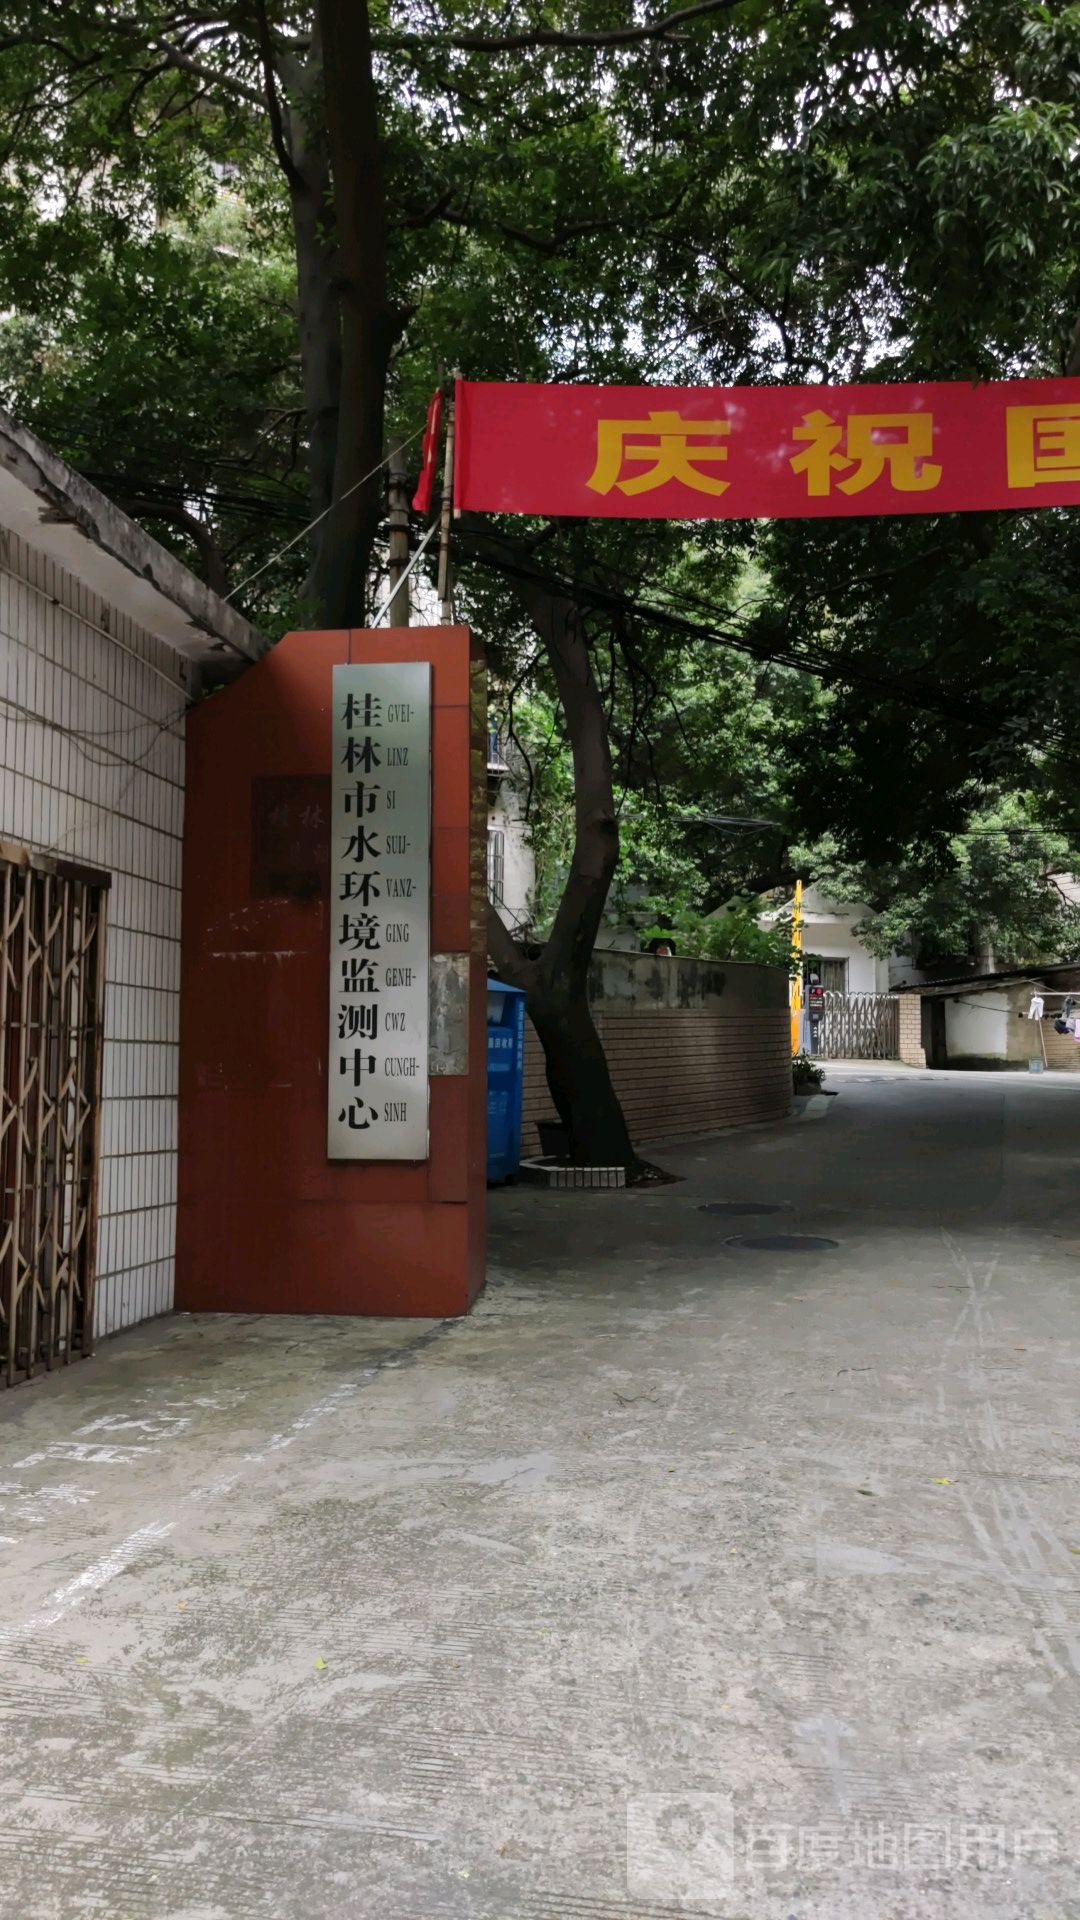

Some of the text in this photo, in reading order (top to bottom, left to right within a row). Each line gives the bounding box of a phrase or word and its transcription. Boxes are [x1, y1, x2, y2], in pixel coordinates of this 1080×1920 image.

[387, 704, 415, 723] GVEI-
[387, 747, 409, 766] LINZ
[386, 790, 396, 809] SI
[386, 835, 411, 855] SUIJ-
[386, 878, 417, 897] VANZ-
[338, 692, 382, 1130] 桂林市水环境监测中心
[385, 923, 410, 943] GING
[385, 968, 417, 987] GENH-
[384, 1012, 406, 1032] CWZ
[384, 1057, 420, 1077] CUNGH-
[383, 1102, 407, 1122] SINH
